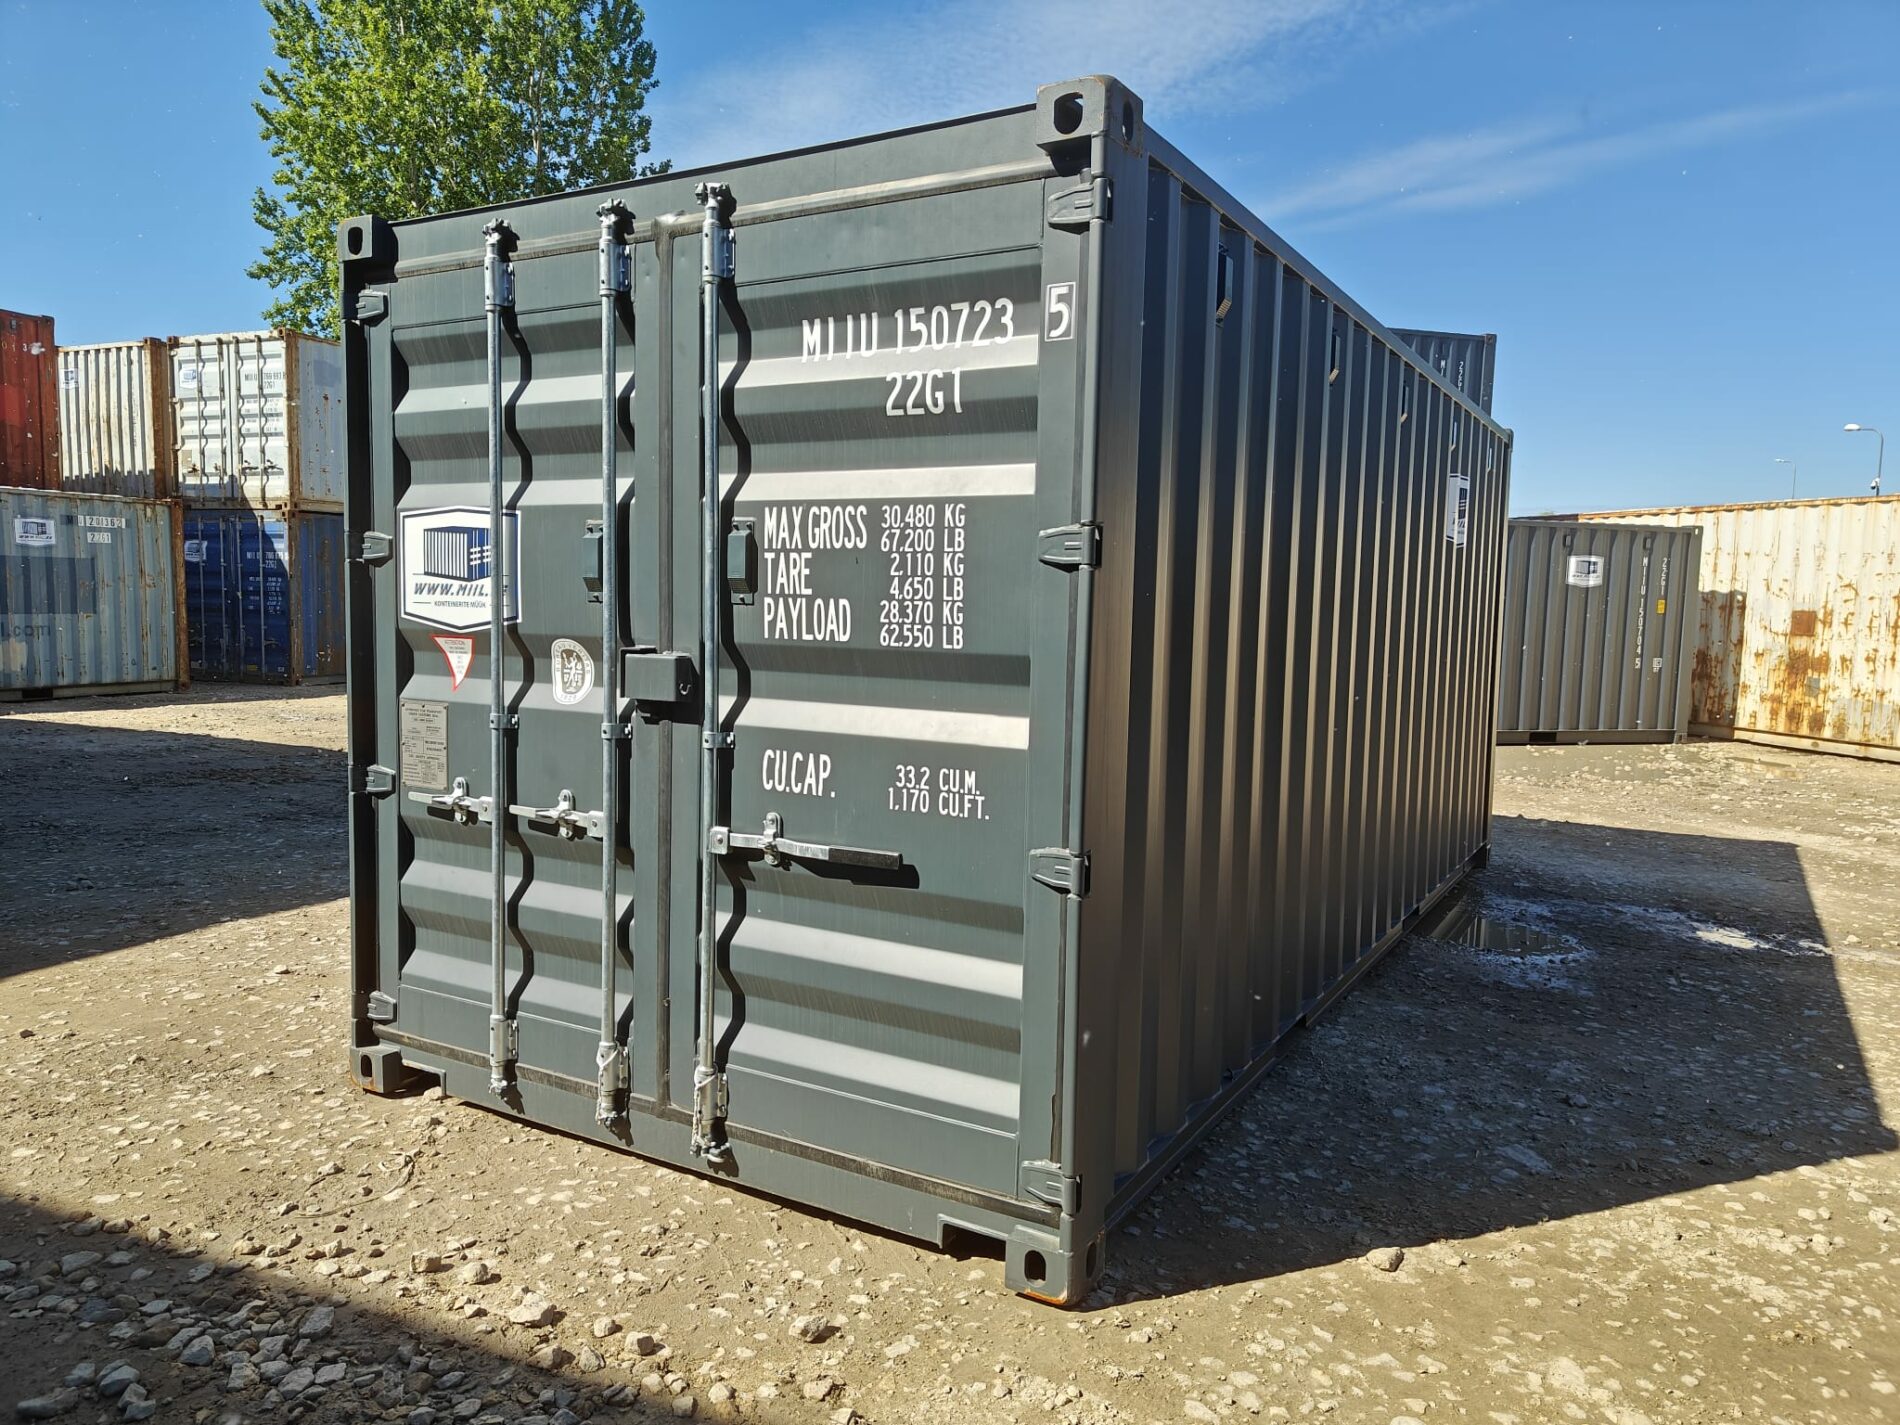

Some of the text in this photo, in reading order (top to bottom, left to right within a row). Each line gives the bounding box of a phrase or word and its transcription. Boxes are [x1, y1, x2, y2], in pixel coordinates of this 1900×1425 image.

[801, 286, 1070, 363] MIIU 150723 5
[885, 367, 963, 416] 22G1
[764, 503, 966, 549] MAX GROSS 30,480 KG
[880, 527, 965, 552] 67,200 LB
[764, 552, 965, 595] TARE 2,110 KG
[889, 576, 964, 601] 4,650 LB
[763, 597, 964, 642] PAYLOAD 28,370 KG
[879, 624, 964, 649] 62,550 LB
[762, 749, 980, 798] CU.CAP. 33.2 CU.M.
[888, 787, 990, 821] 1,170 CU.FT.
